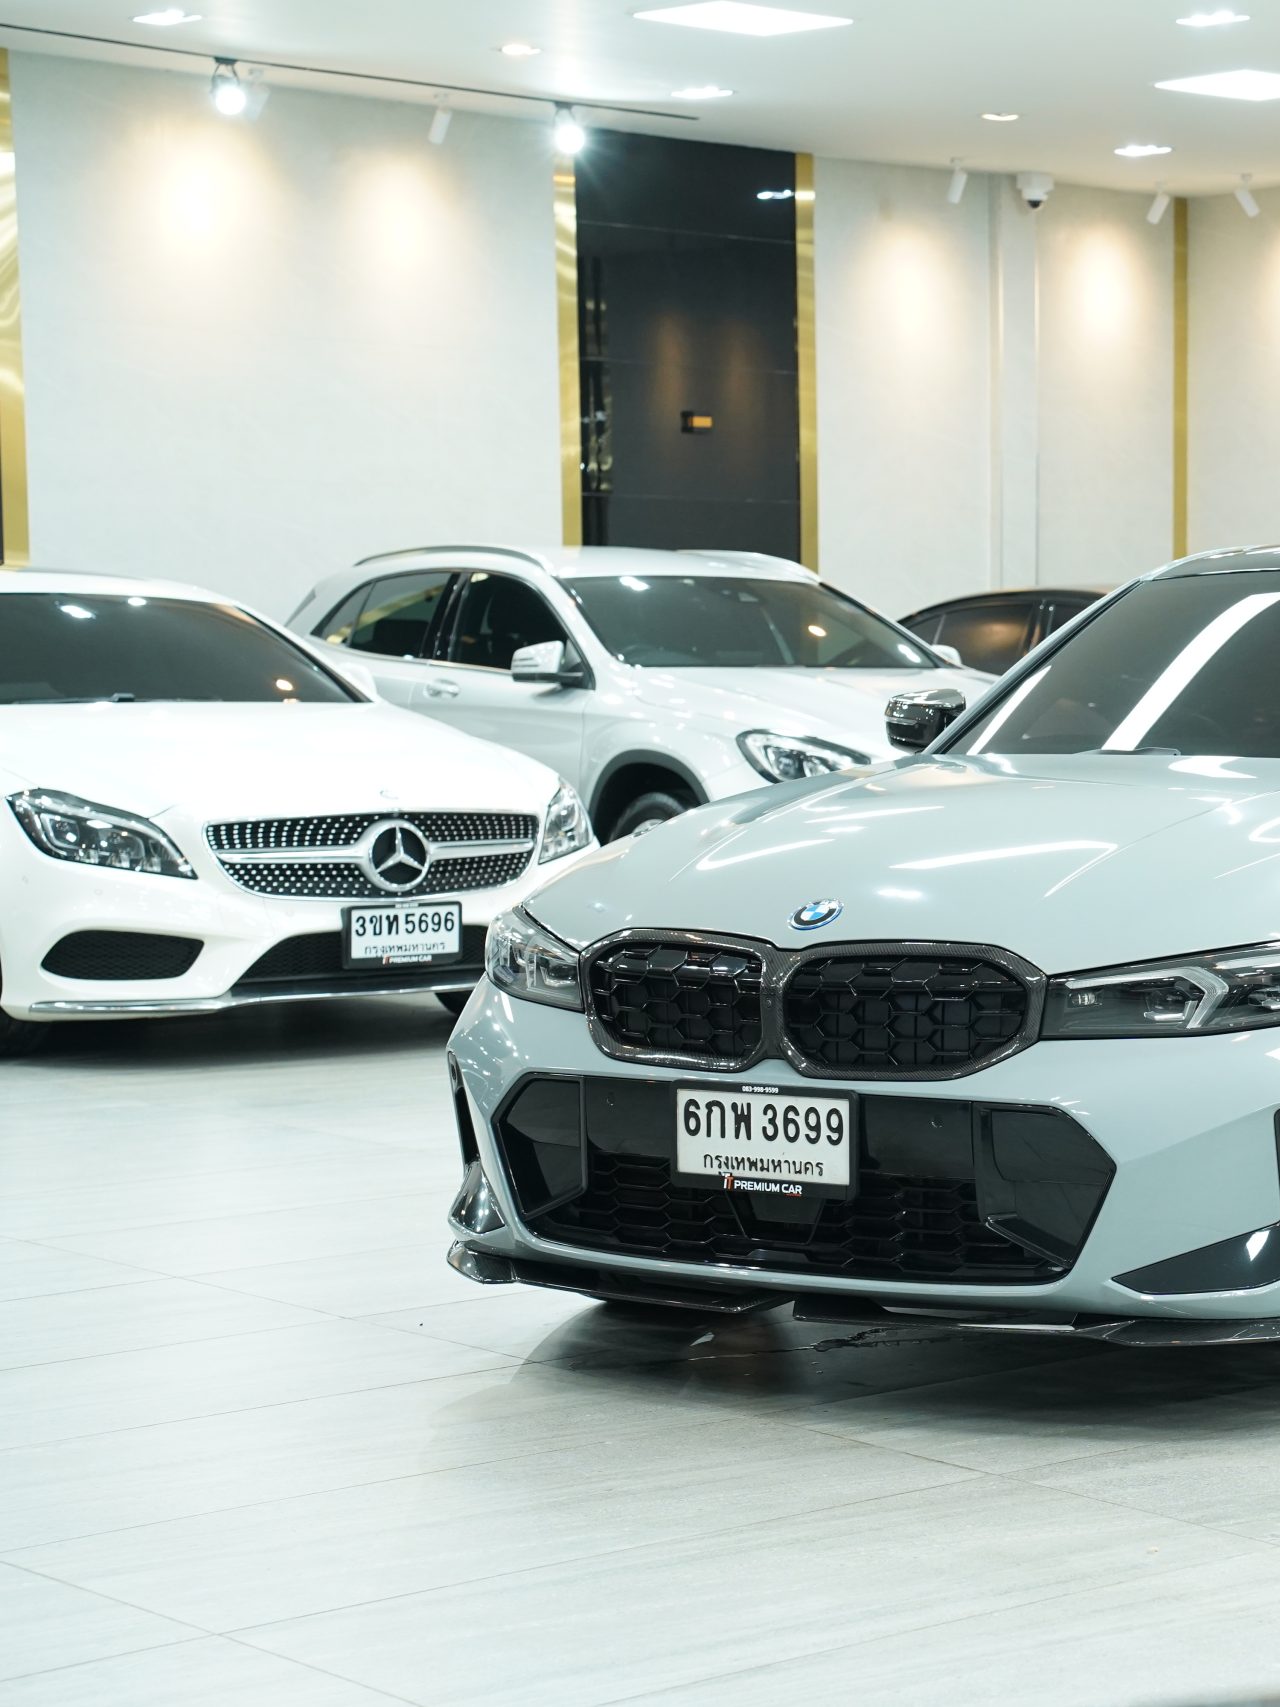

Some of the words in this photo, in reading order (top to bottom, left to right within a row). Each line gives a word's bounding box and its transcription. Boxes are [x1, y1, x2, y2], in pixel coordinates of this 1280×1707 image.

[405, 912, 455, 934] 5696
[364, 942, 446, 955] กรงเทพมหานคร
[684, 1099, 752, 1140] 6กพ
[762, 1103, 844, 1146] 3699
[703, 1153, 824, 1177] กรงเทพมหานคร
[734, 1180, 780, 1193] PREMIUM
[781, 1184, 802, 1195] CAR
